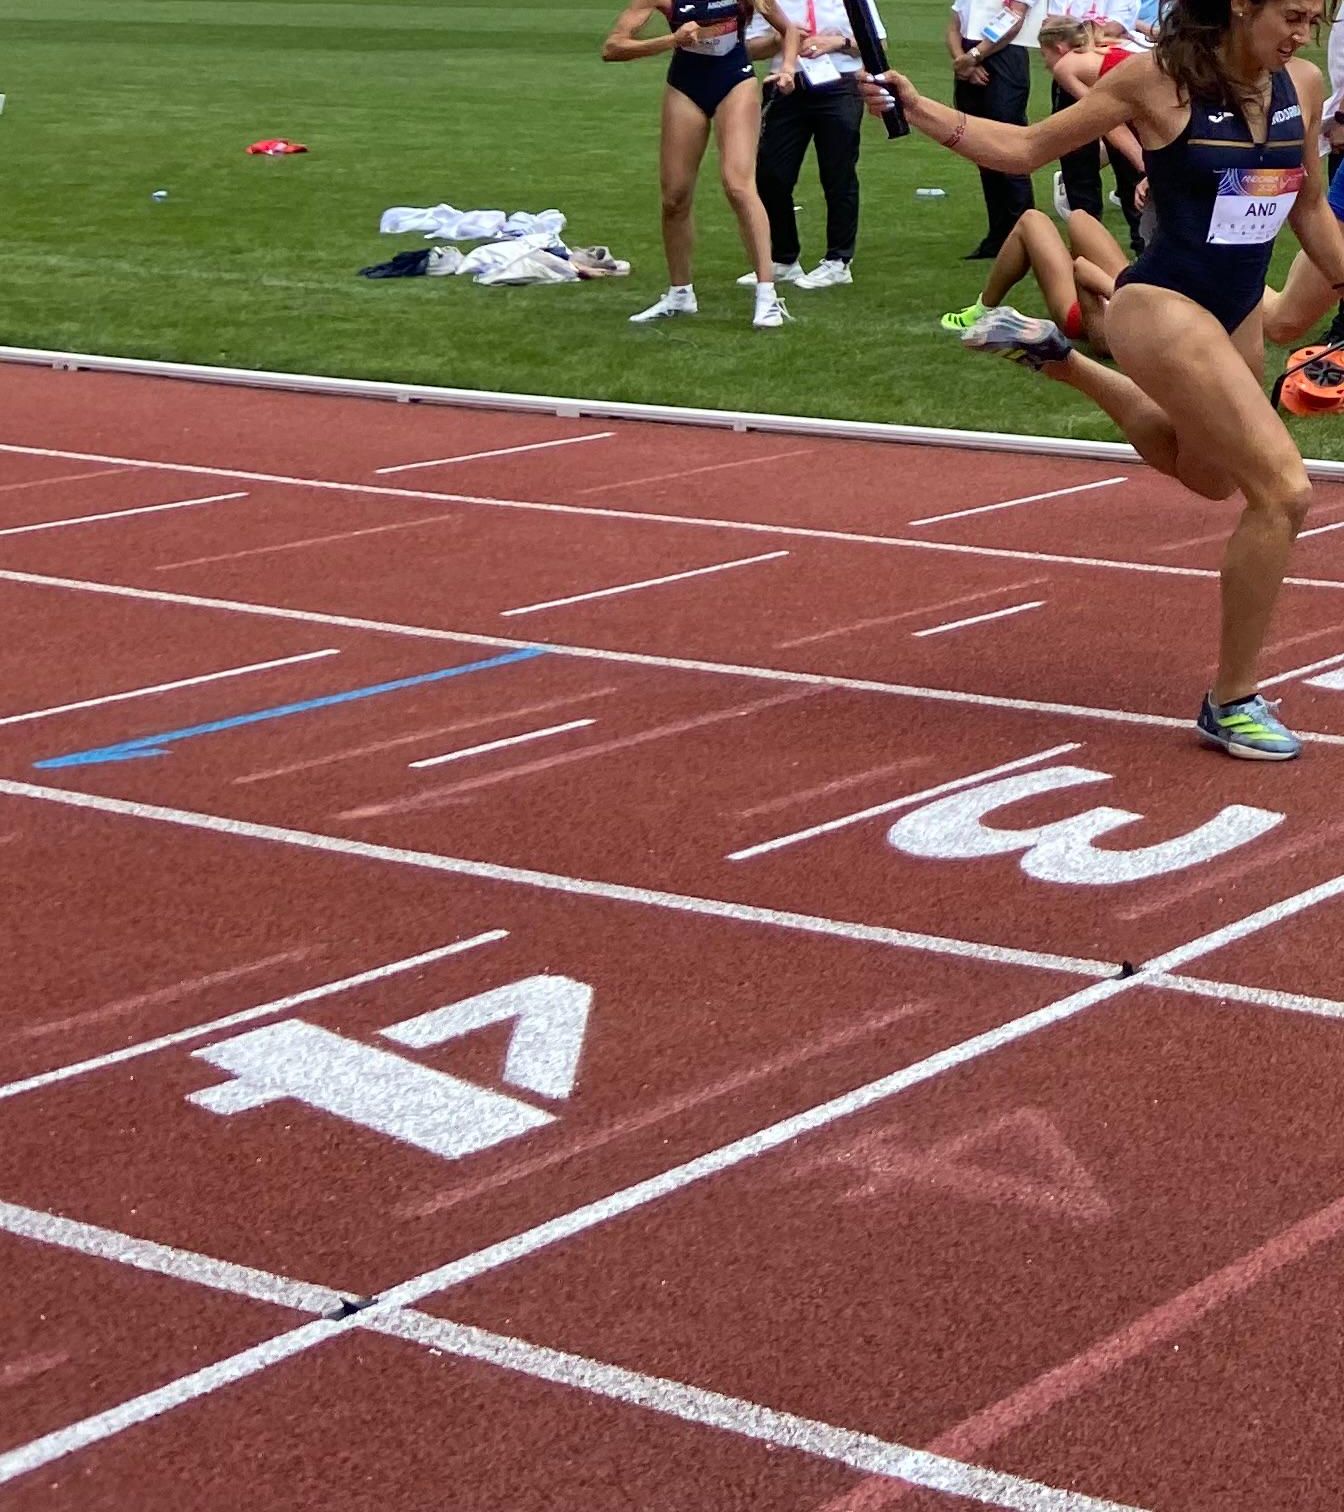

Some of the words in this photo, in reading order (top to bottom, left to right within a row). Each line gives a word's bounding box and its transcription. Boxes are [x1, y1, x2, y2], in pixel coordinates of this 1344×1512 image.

[1244, 202, 1278, 217] AND
[886, 765, 1287, 887] 3
[184, 972, 594, 1161] 4
